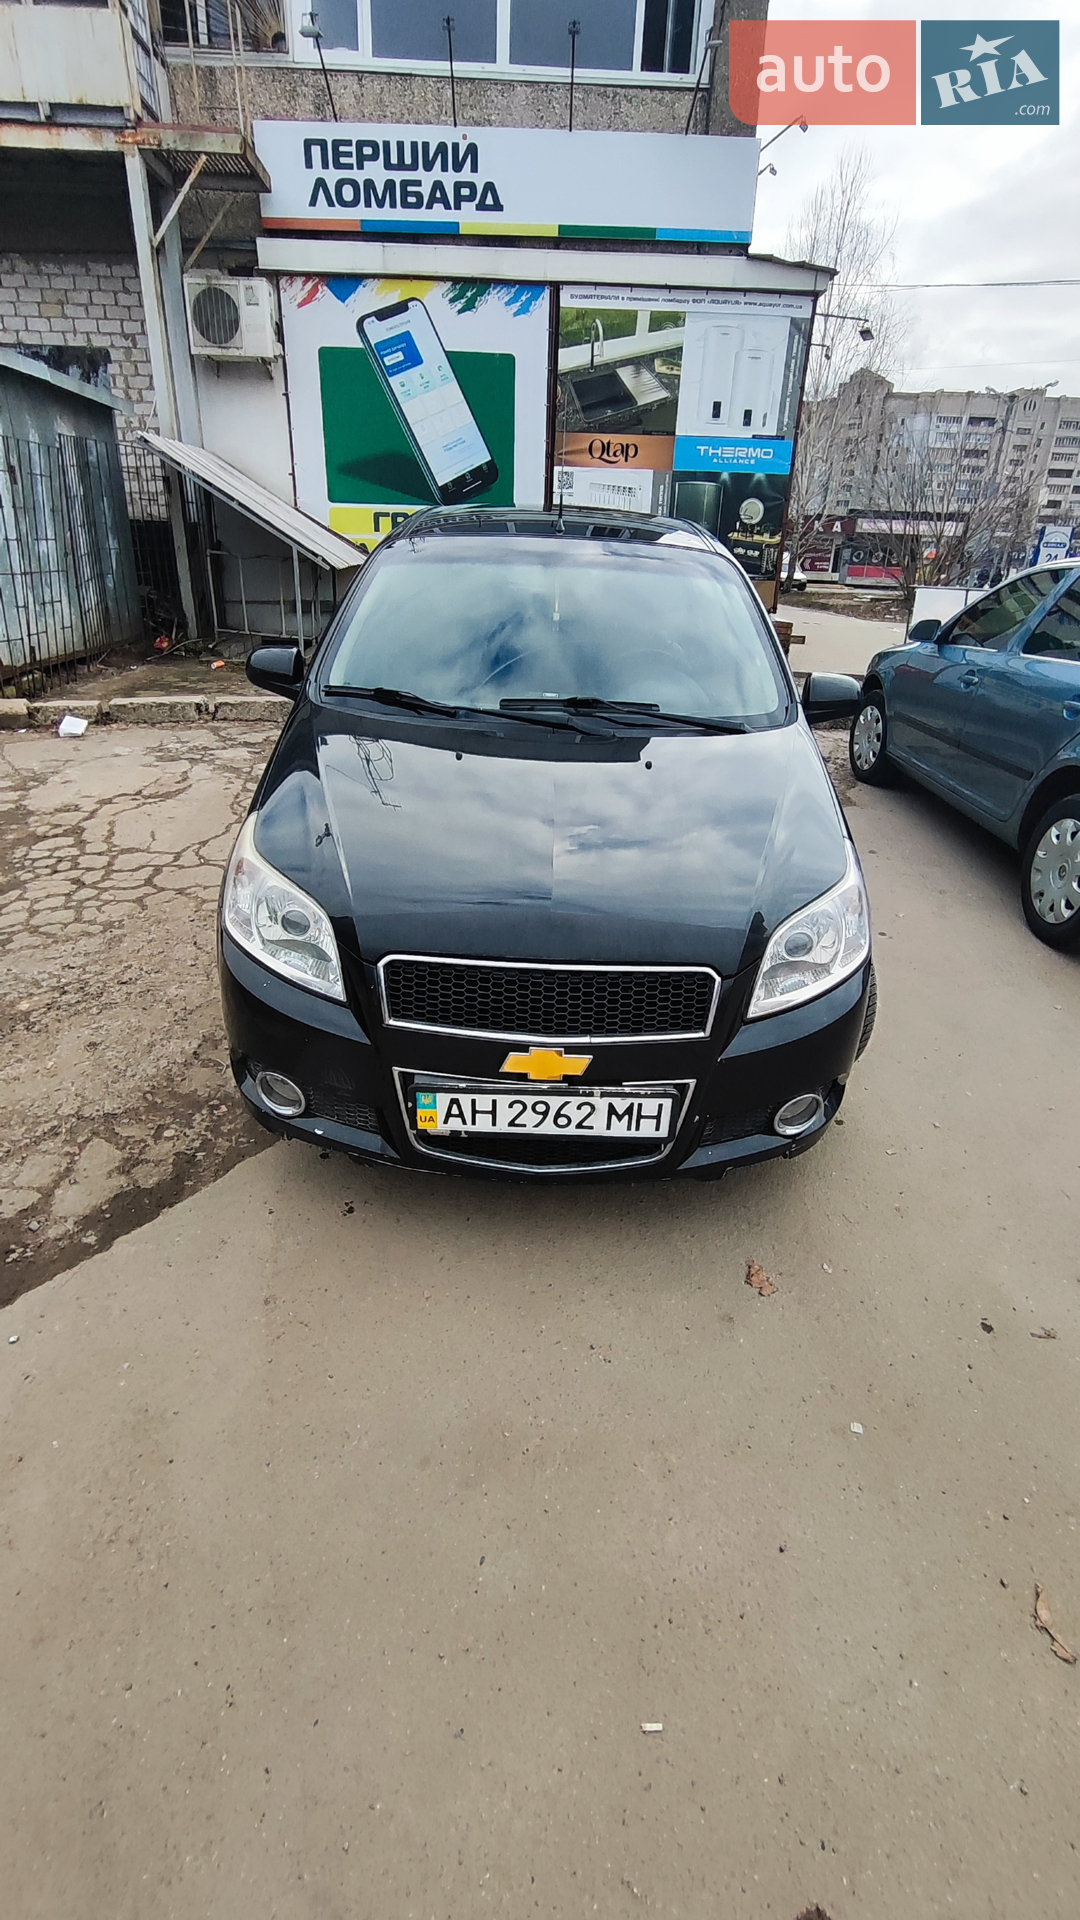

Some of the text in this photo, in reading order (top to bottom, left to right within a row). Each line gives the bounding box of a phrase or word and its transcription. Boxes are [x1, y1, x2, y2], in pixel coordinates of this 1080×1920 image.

[303, 134, 479, 174] ПЕРШИЙ
[308, 177, 504, 212] ЛОМБАРД
[588, 438, 639, 464] Qtap
[696, 445, 774, 459] THERMO
[712, 457, 756, 465] ALLIANCE
[419, 1114, 436, 1124] UA
[442, 1097, 664, 1132] AH 2962 MH
